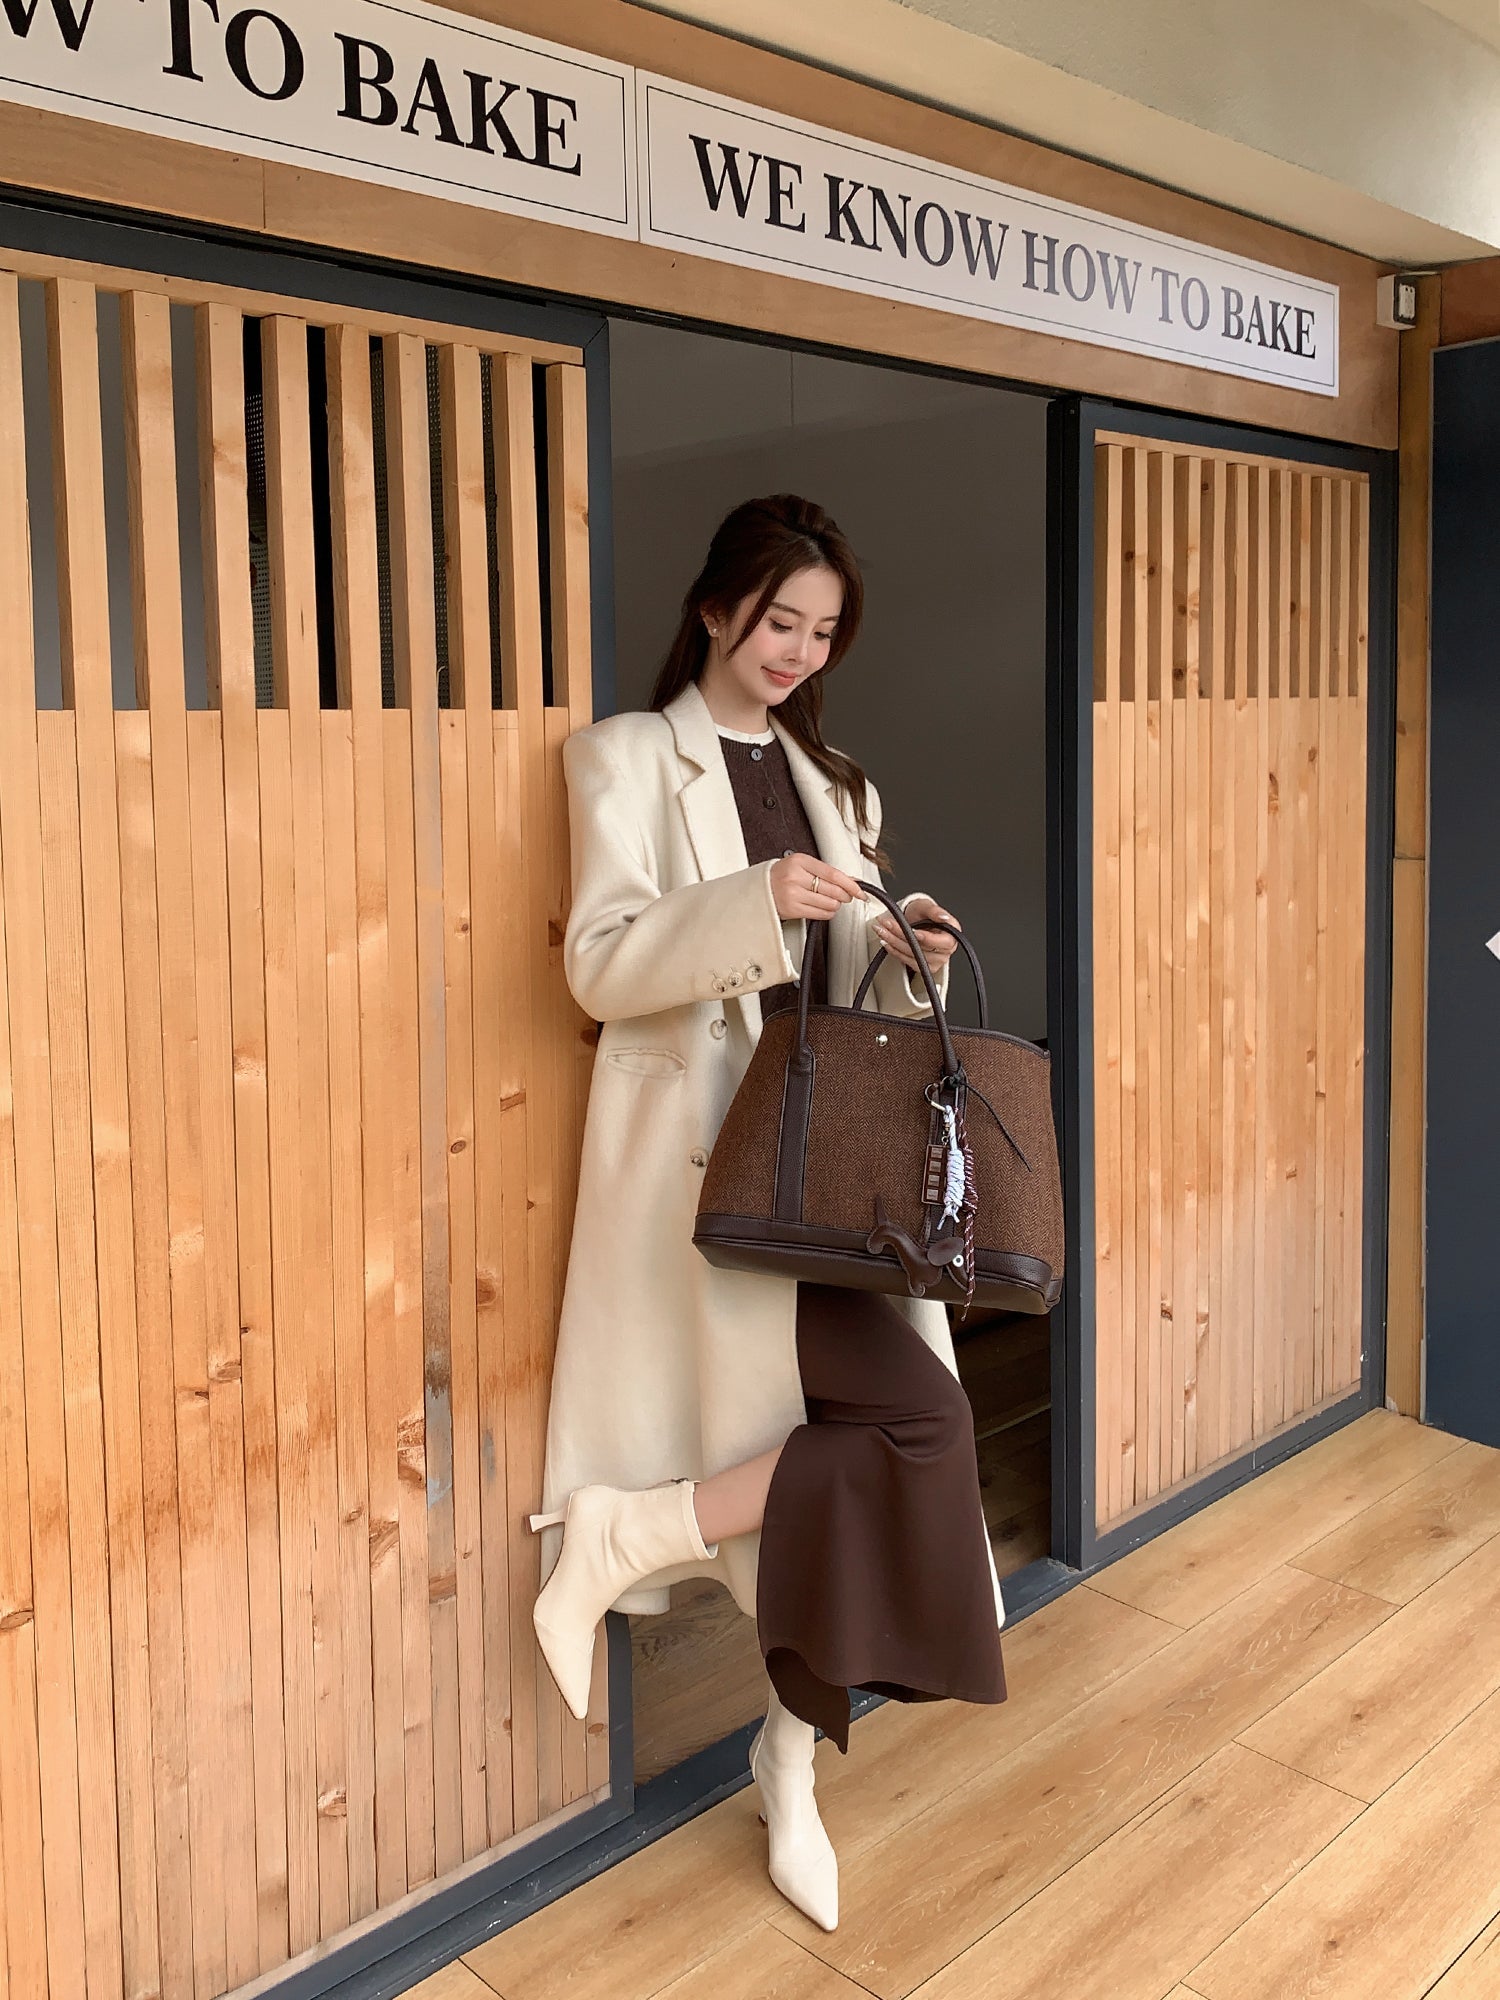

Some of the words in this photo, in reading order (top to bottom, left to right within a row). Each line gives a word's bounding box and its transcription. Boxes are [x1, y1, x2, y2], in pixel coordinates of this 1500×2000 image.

[138, 0, 304, 101] TO
[333, 32, 582, 177] BAKE
[688, 133, 806, 234] WE
[823, 172, 1010, 281] KNOW
[1021, 229, 1143, 314] HOW
[1151, 266, 1211, 331] TO
[1221, 286, 1317, 360] BAKE
